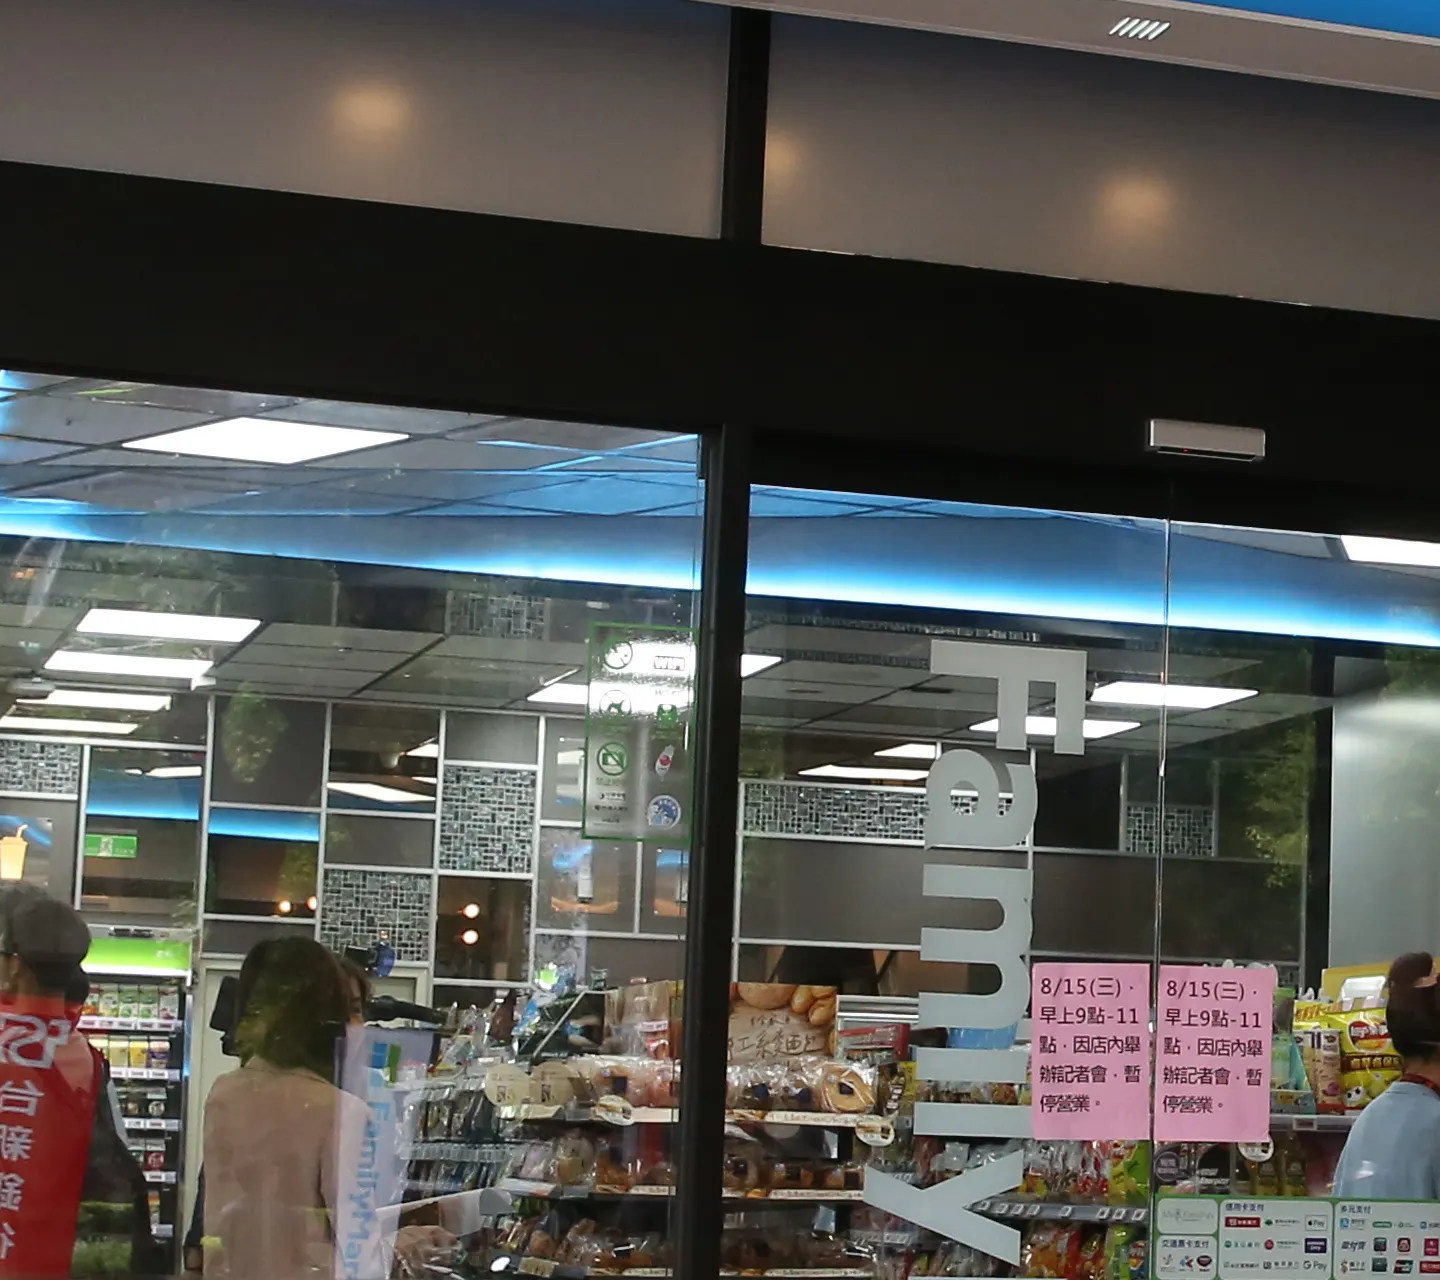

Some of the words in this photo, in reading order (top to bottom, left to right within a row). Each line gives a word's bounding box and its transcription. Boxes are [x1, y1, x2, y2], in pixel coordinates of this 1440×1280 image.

[1039, 1006, 1140, 1026] 早上9點-11
[1164, 1008, 1262, 1029] 早上9點-11
